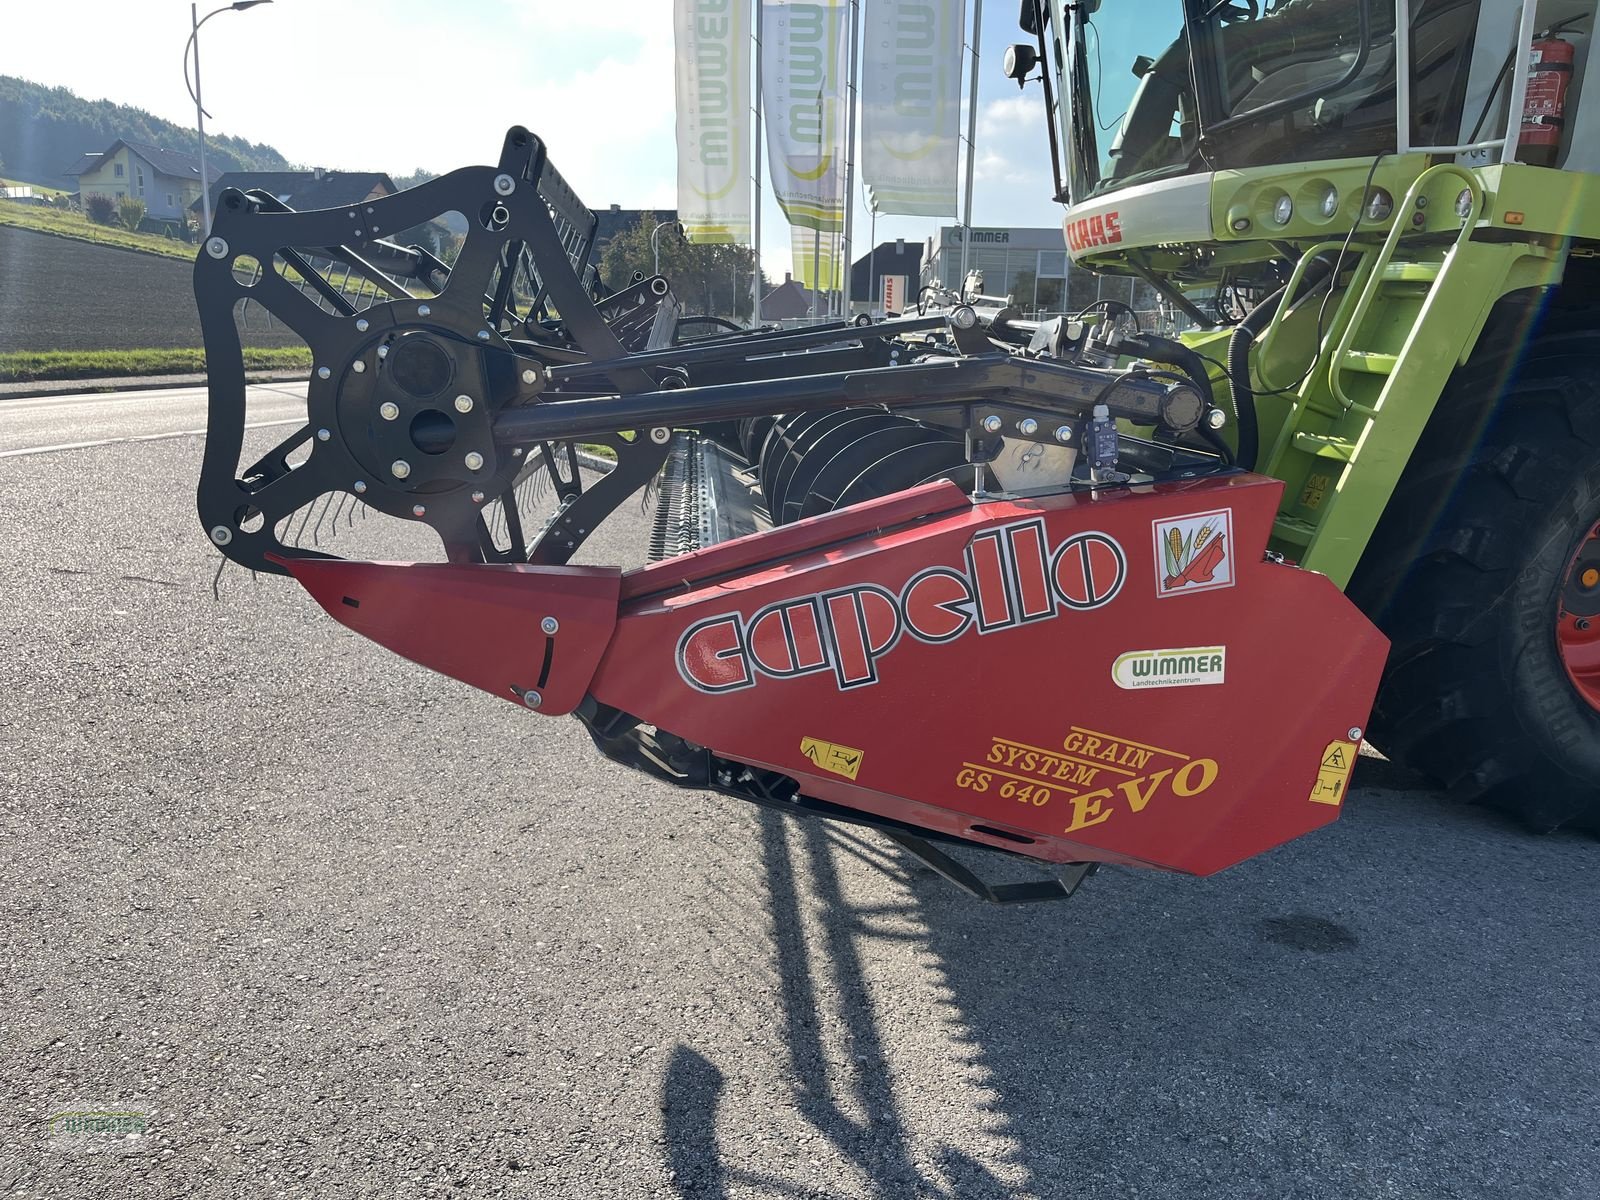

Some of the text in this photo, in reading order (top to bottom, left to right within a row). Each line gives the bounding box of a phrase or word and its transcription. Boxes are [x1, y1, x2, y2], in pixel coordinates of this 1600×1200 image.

[1067, 211, 1122, 252] CLAAS
[1132, 655, 1222, 677] WIMMER
[1132, 677, 1200, 687] Landtechnikzentrum
[987, 743, 1100, 787] SYSTEM
[1063, 732, 1154, 769] GRAIN
[956, 768, 1050, 806] GS 640
[1064, 758, 1219, 833] EVO
